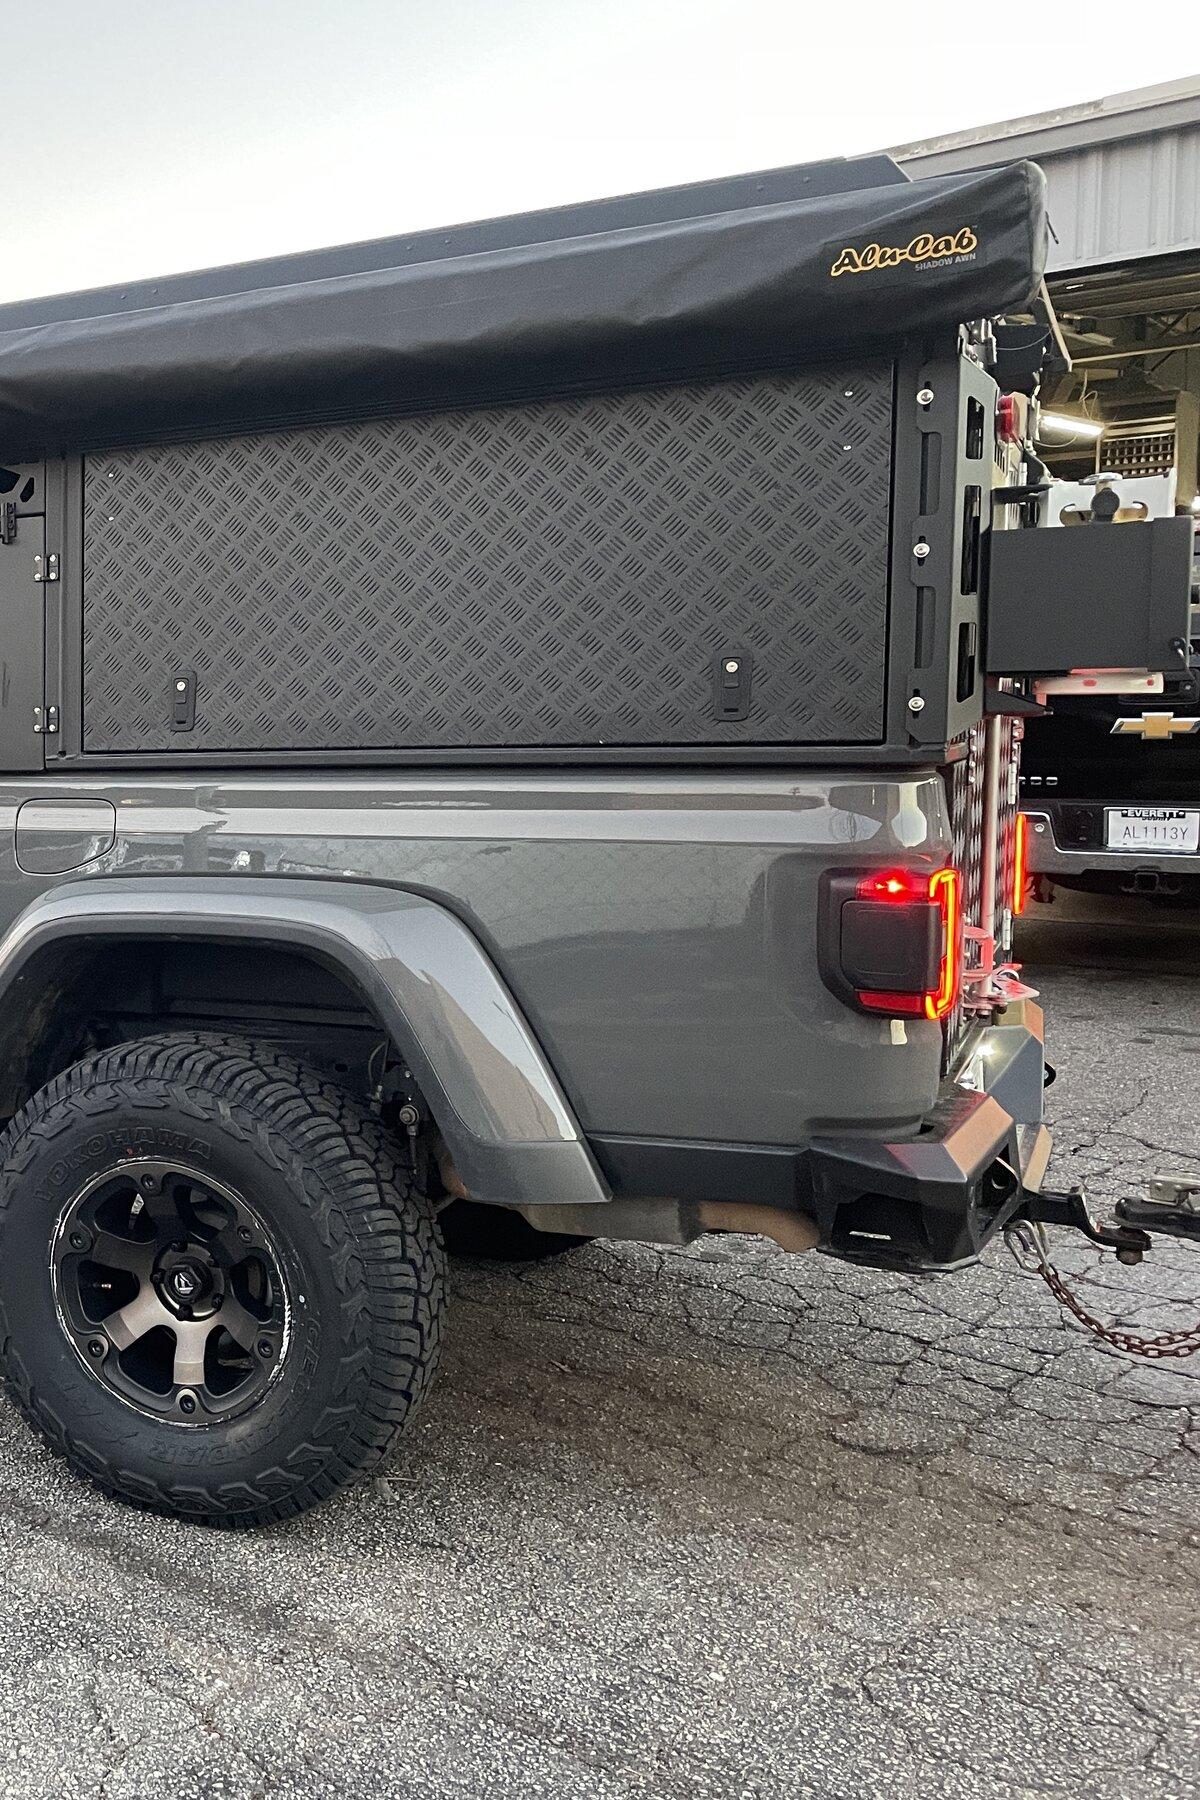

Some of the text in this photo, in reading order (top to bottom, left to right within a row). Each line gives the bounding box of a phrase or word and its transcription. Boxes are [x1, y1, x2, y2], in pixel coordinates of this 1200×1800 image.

[830, 227, 978, 277] Alu-Cab
[915, 252, 977, 271] SHADOW AWN
[1127, 809, 1179, 818] EVERETT
[1122, 825, 1189, 840] AL1113Y
[31, 1125, 213, 1203] YOKOHAMA
